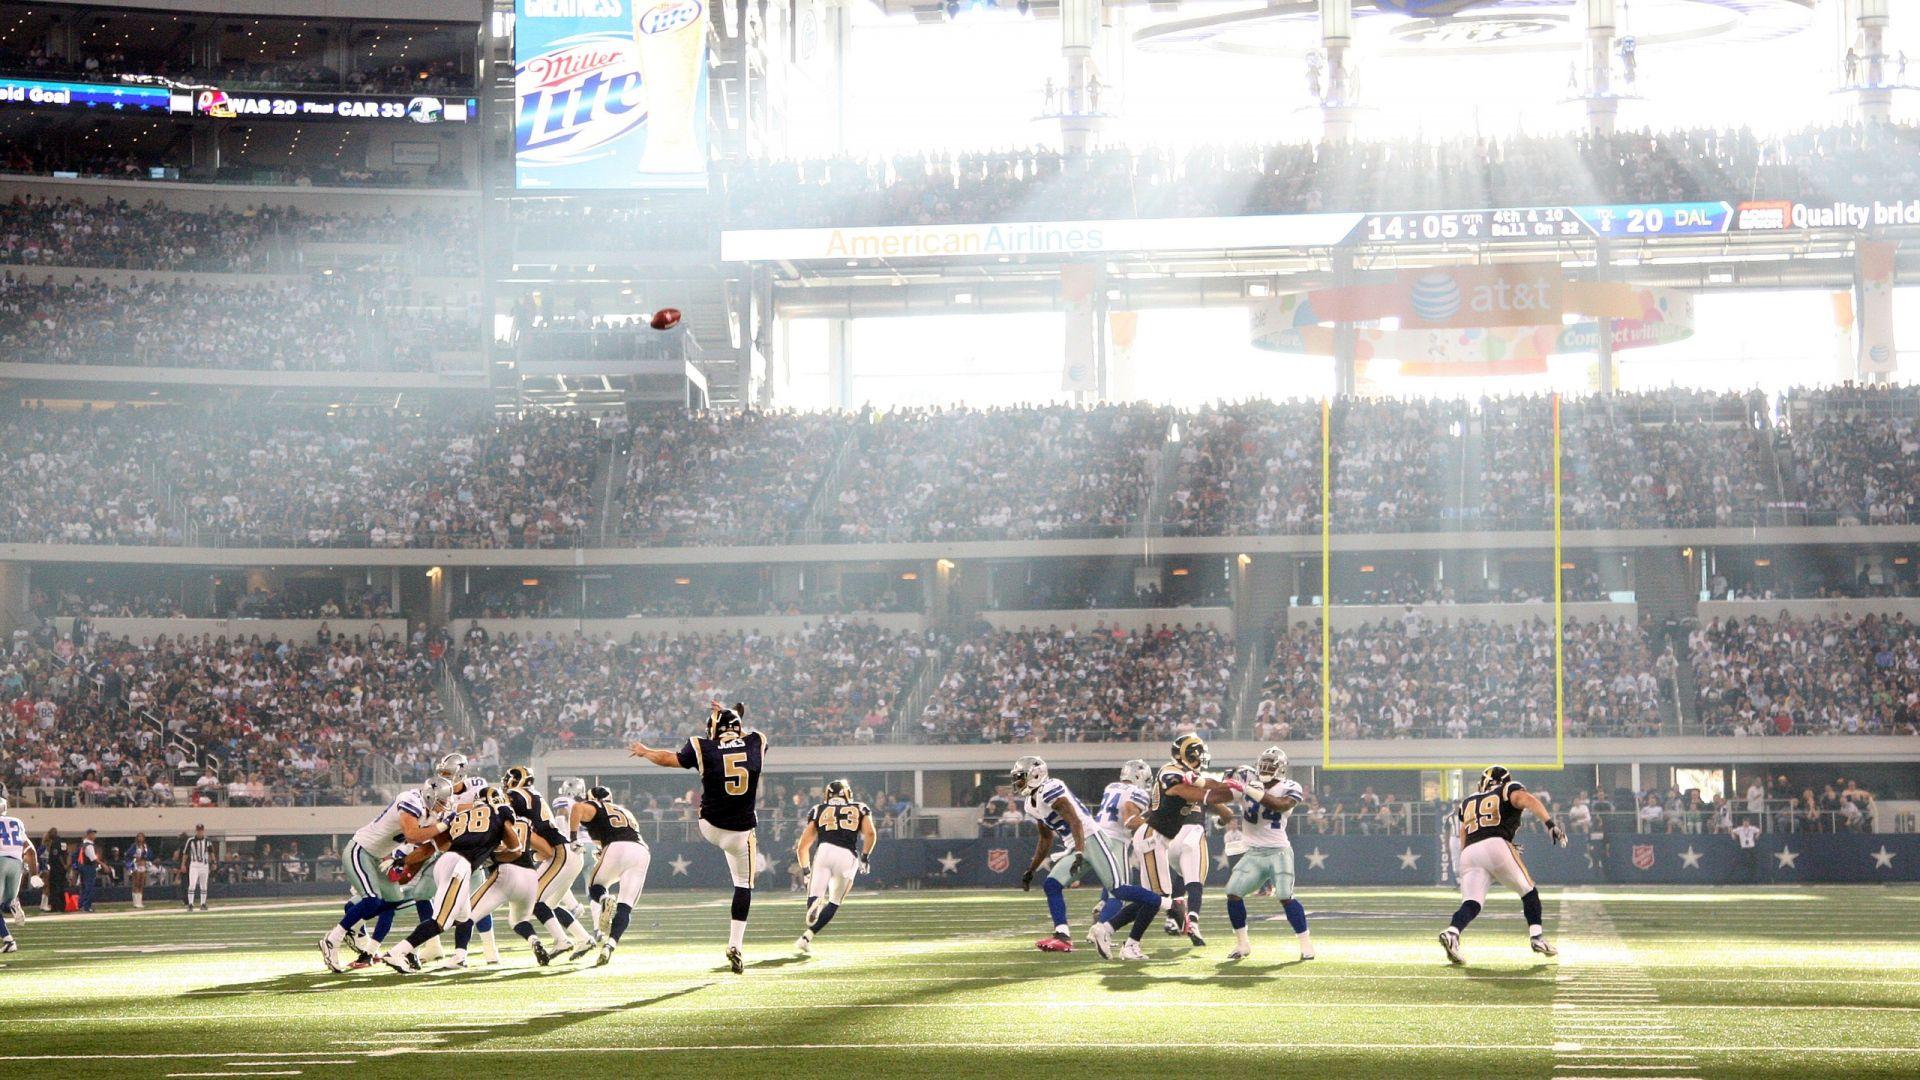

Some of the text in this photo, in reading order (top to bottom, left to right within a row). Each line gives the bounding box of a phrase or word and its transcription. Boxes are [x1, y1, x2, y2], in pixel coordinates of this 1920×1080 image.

[528, 51, 624, 84] Miller
[29, 89, 71, 104] Goal
[230, 98, 271, 114] WAS
[273, 100, 298, 115] 20
[338, 102, 379, 117] CAR
[382, 103, 406, 117] 33
[516, 72, 642, 152] Lite
[1367, 212, 1460, 236] 14:05
[1493, 209, 1521, 223] 4th
[1544, 208, 1564, 222] 10
[1534, 222, 1554, 235] On
[1627, 208, 1713, 233] 20 DAL
[1791, 202, 1870, 230] Quality
[1467, 223, 1479, 236] 4
[1471, 277, 1552, 311] at&t
[723, 752, 749, 796] 5
[449, 805, 491, 841] 88
[818, 805, 860, 831] 43
[1463, 794, 1501, 835] 49
